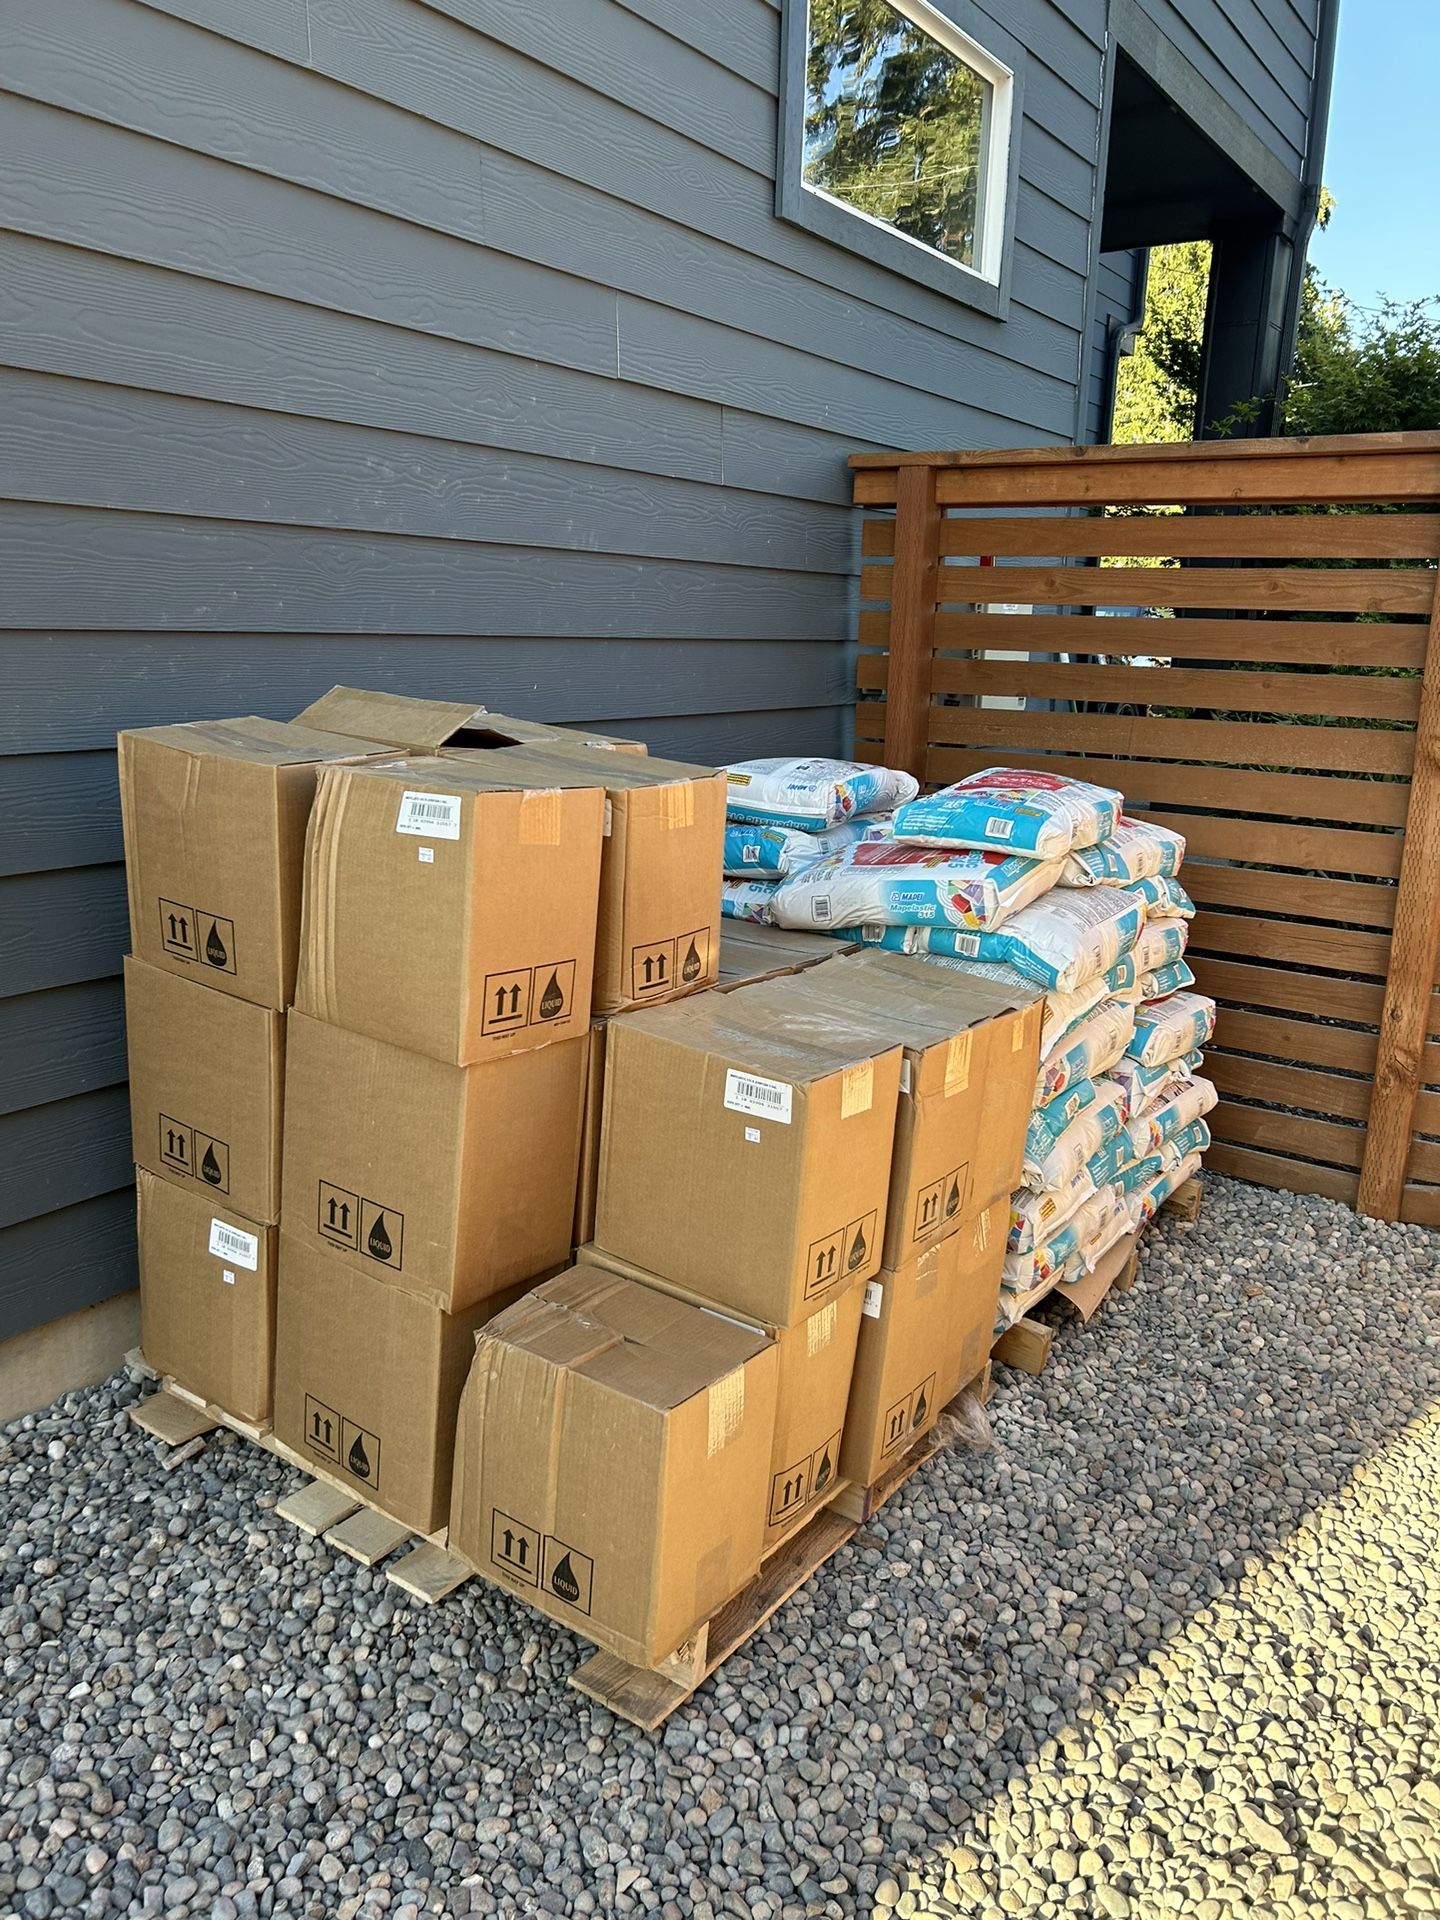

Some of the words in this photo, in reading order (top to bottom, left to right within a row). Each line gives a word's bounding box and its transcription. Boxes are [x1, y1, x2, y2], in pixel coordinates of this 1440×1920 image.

[901, 893, 924, 901] MAPEI
[890, 904, 936, 913] Mapelastic
[207, 947, 226, 961] LIQUID
[541, 998, 562, 1010] LIQUID
[370, 1237, 390, 1253] LIQUID
[351, 1454, 369, 1471] LIQUID
[554, 1576, 578, 1595] LIQUID
